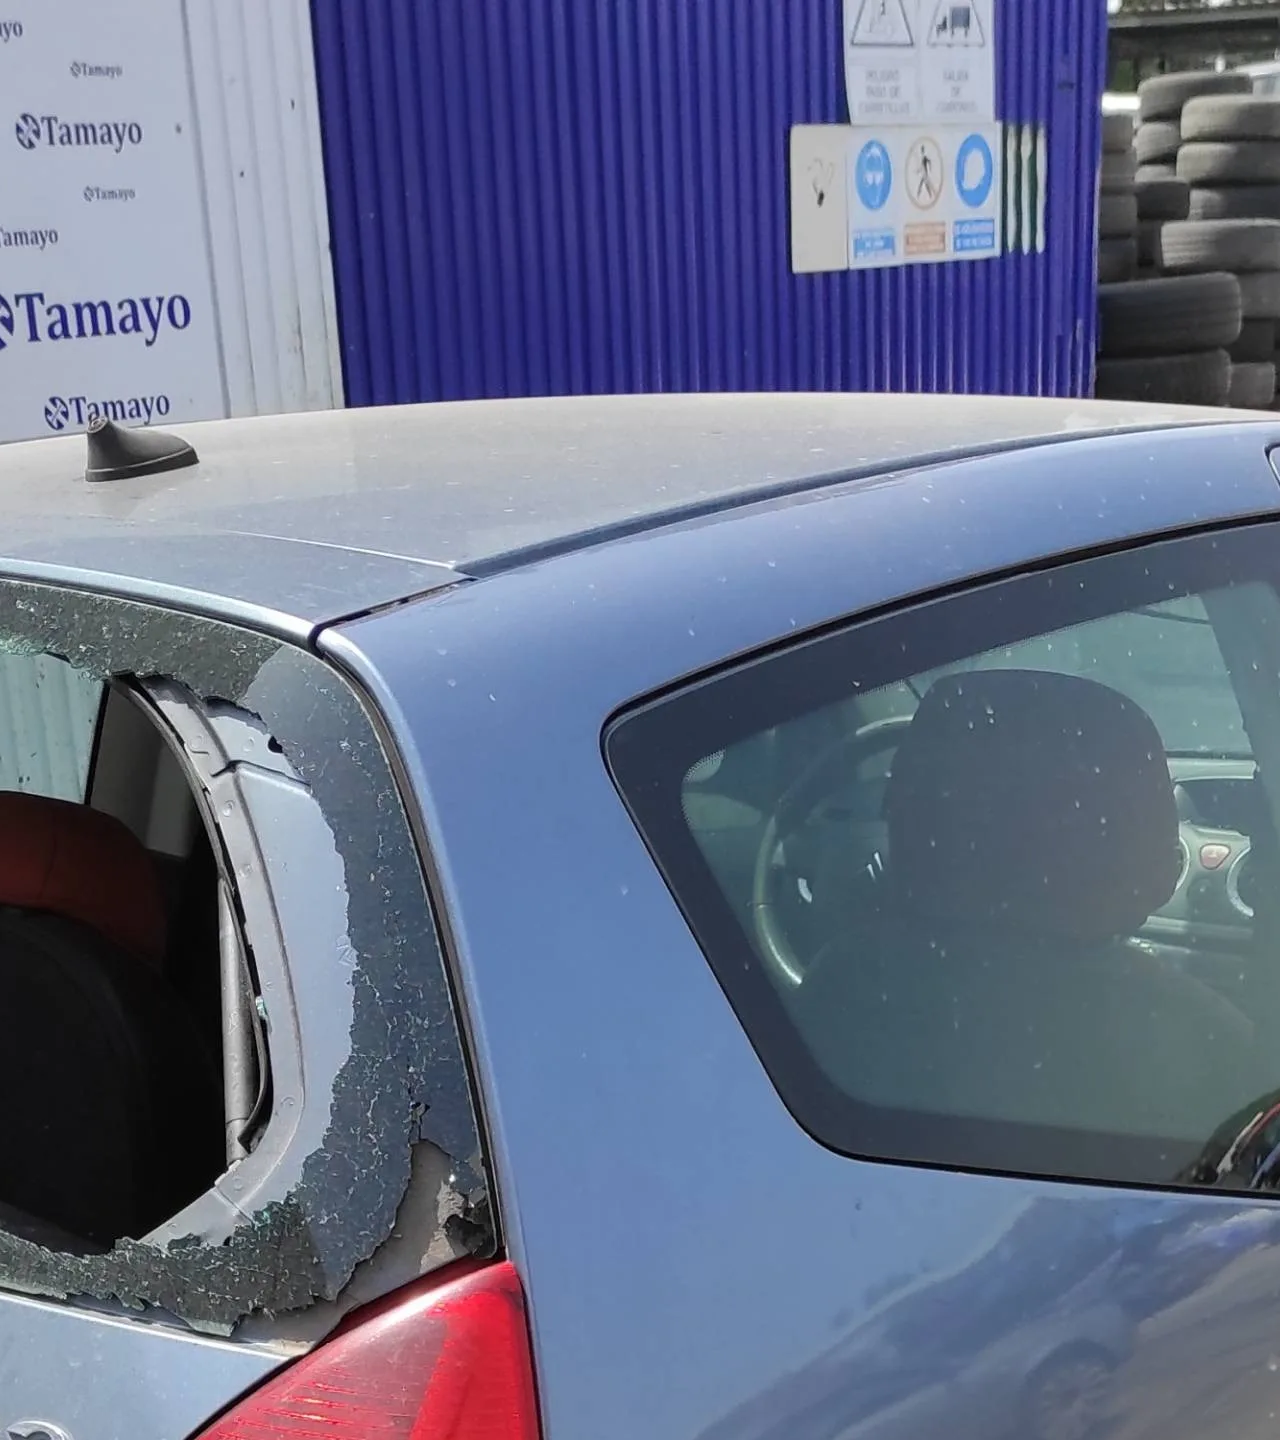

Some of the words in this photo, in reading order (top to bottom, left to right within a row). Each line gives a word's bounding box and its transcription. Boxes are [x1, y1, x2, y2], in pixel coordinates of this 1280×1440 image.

[40, 116, 143, 154] Tamayo
[14, 292, 191, 347] Tamayo
[67, 394, 171, 425] Tamayo
